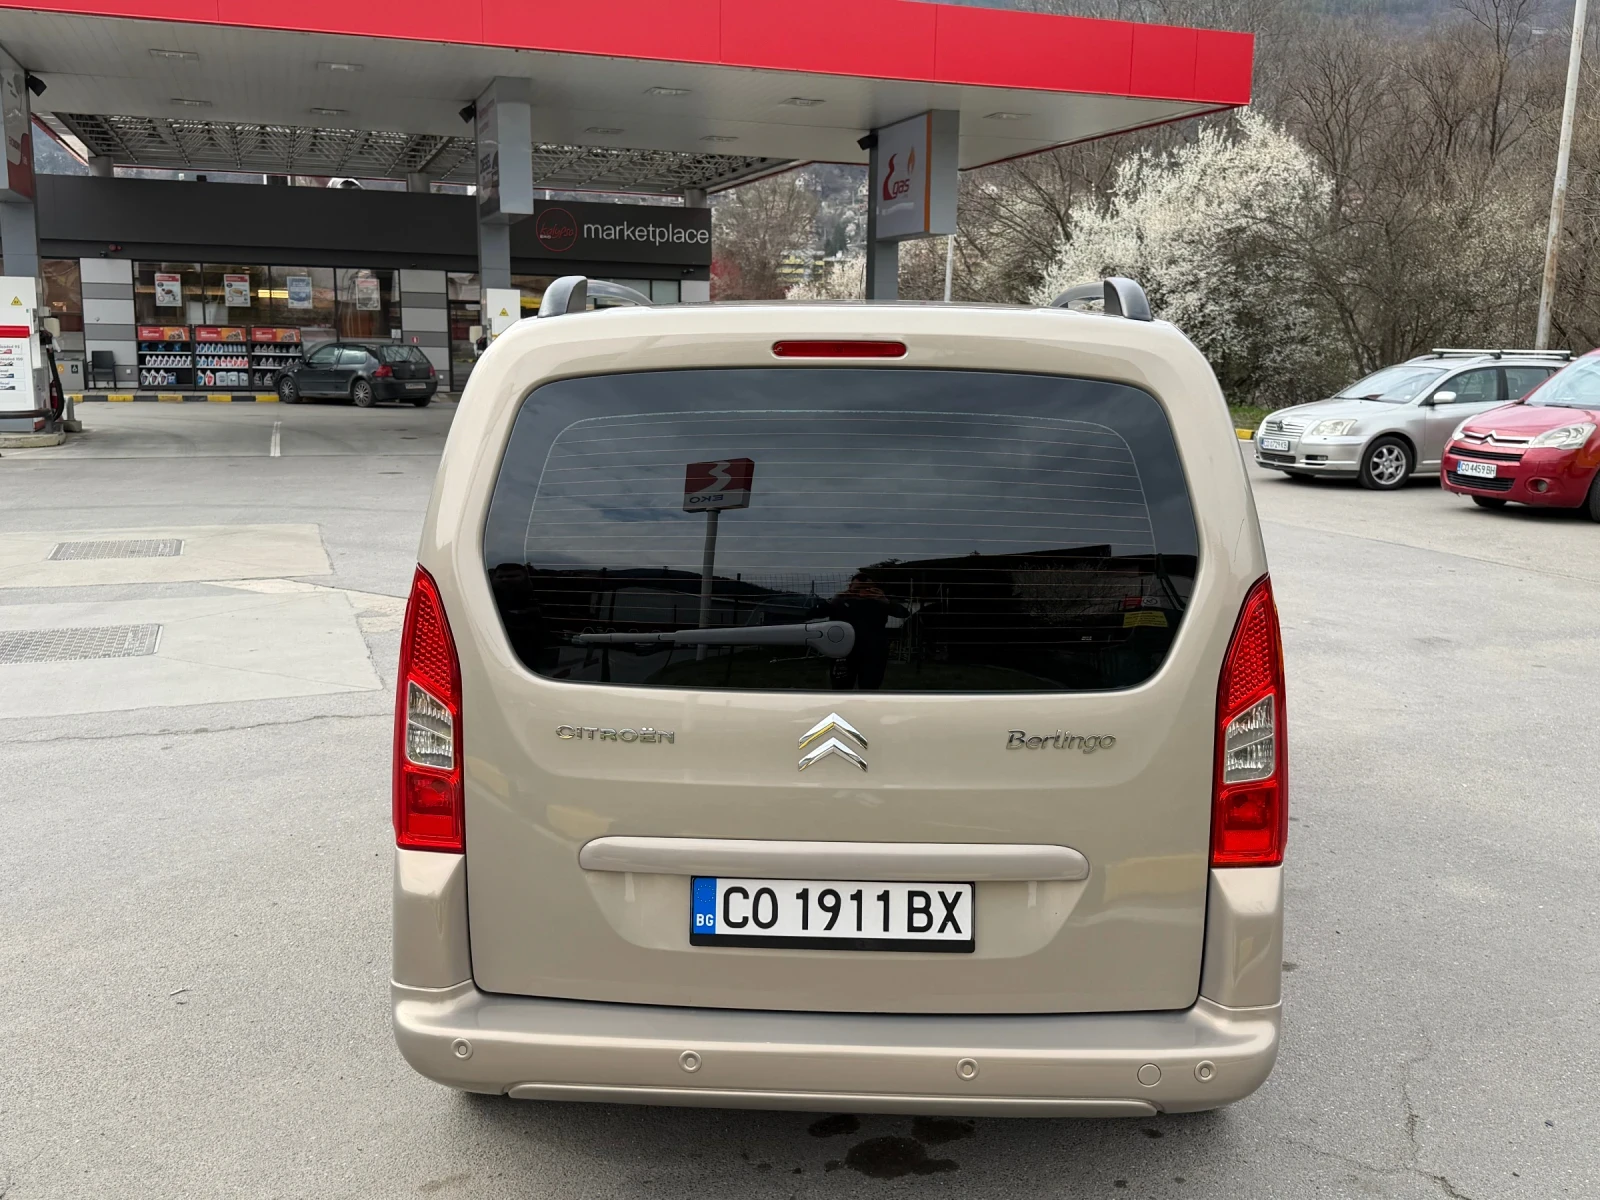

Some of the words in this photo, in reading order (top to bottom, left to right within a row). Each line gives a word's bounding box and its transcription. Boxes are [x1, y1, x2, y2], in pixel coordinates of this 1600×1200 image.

[583, 221, 709, 246] marketplace
[1461, 462, 1470, 472] CO
[1470, 463, 1486, 474] 4459
[1486, 465, 1496, 475] BH
[555, 724, 675, 744] CITROËN
[1005, 729, 1117, 755] Berlingo
[696, 914, 714, 927] BG
[723, 886, 779, 930] CO
[796, 887, 890, 933] 1911
[907, 890, 963, 934] BX
